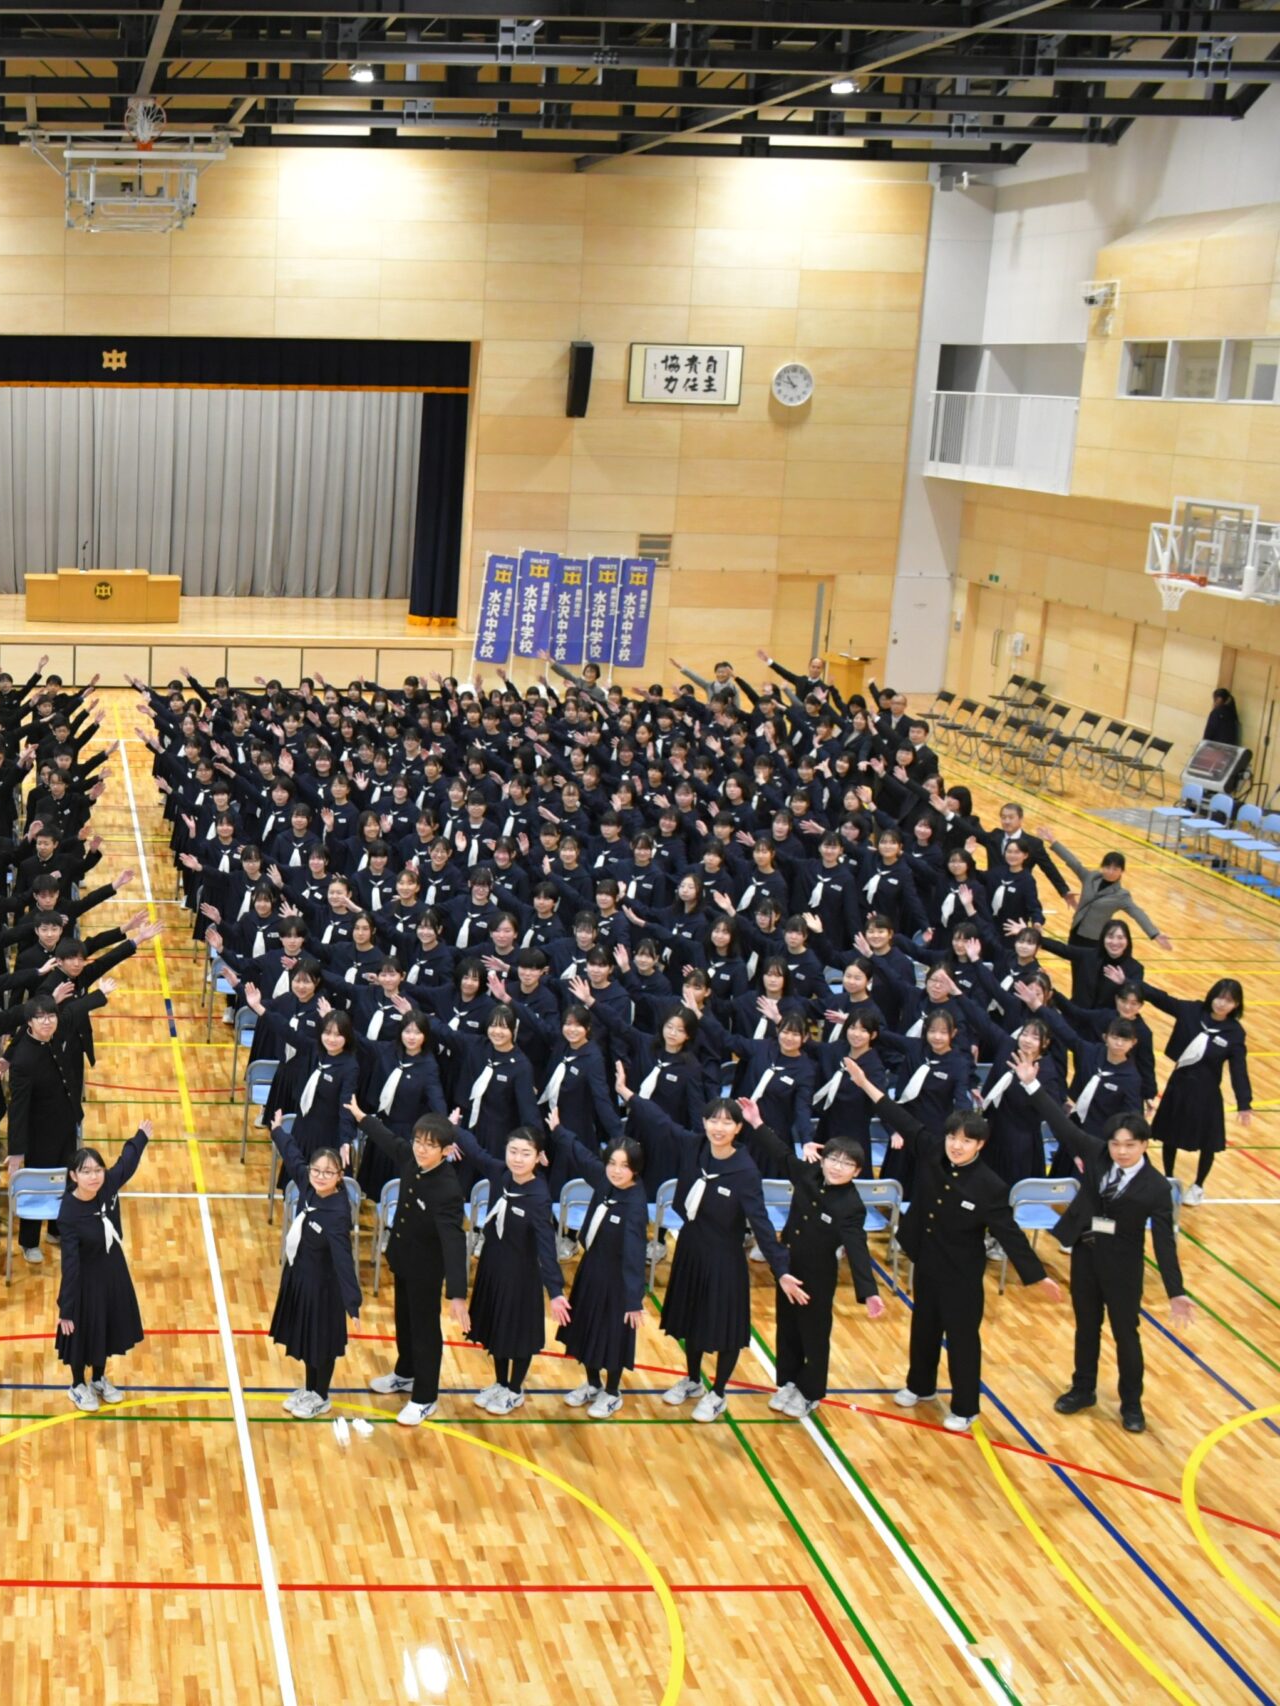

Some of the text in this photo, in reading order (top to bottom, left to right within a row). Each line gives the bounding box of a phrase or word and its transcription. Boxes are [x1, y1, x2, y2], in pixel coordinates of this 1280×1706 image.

[661, 354, 680, 394] 協力
[683, 354, 701, 392] 責任
[703, 355, 718, 392] 自主
[480, 590, 502, 658] 水沢中学校
[519, 585, 538, 654] 水沢中学校
[555, 592, 571, 661] 水沢中学校
[590, 591, 607, 658] 水沢中学校
[618, 593, 637, 661] 水沢中学校
